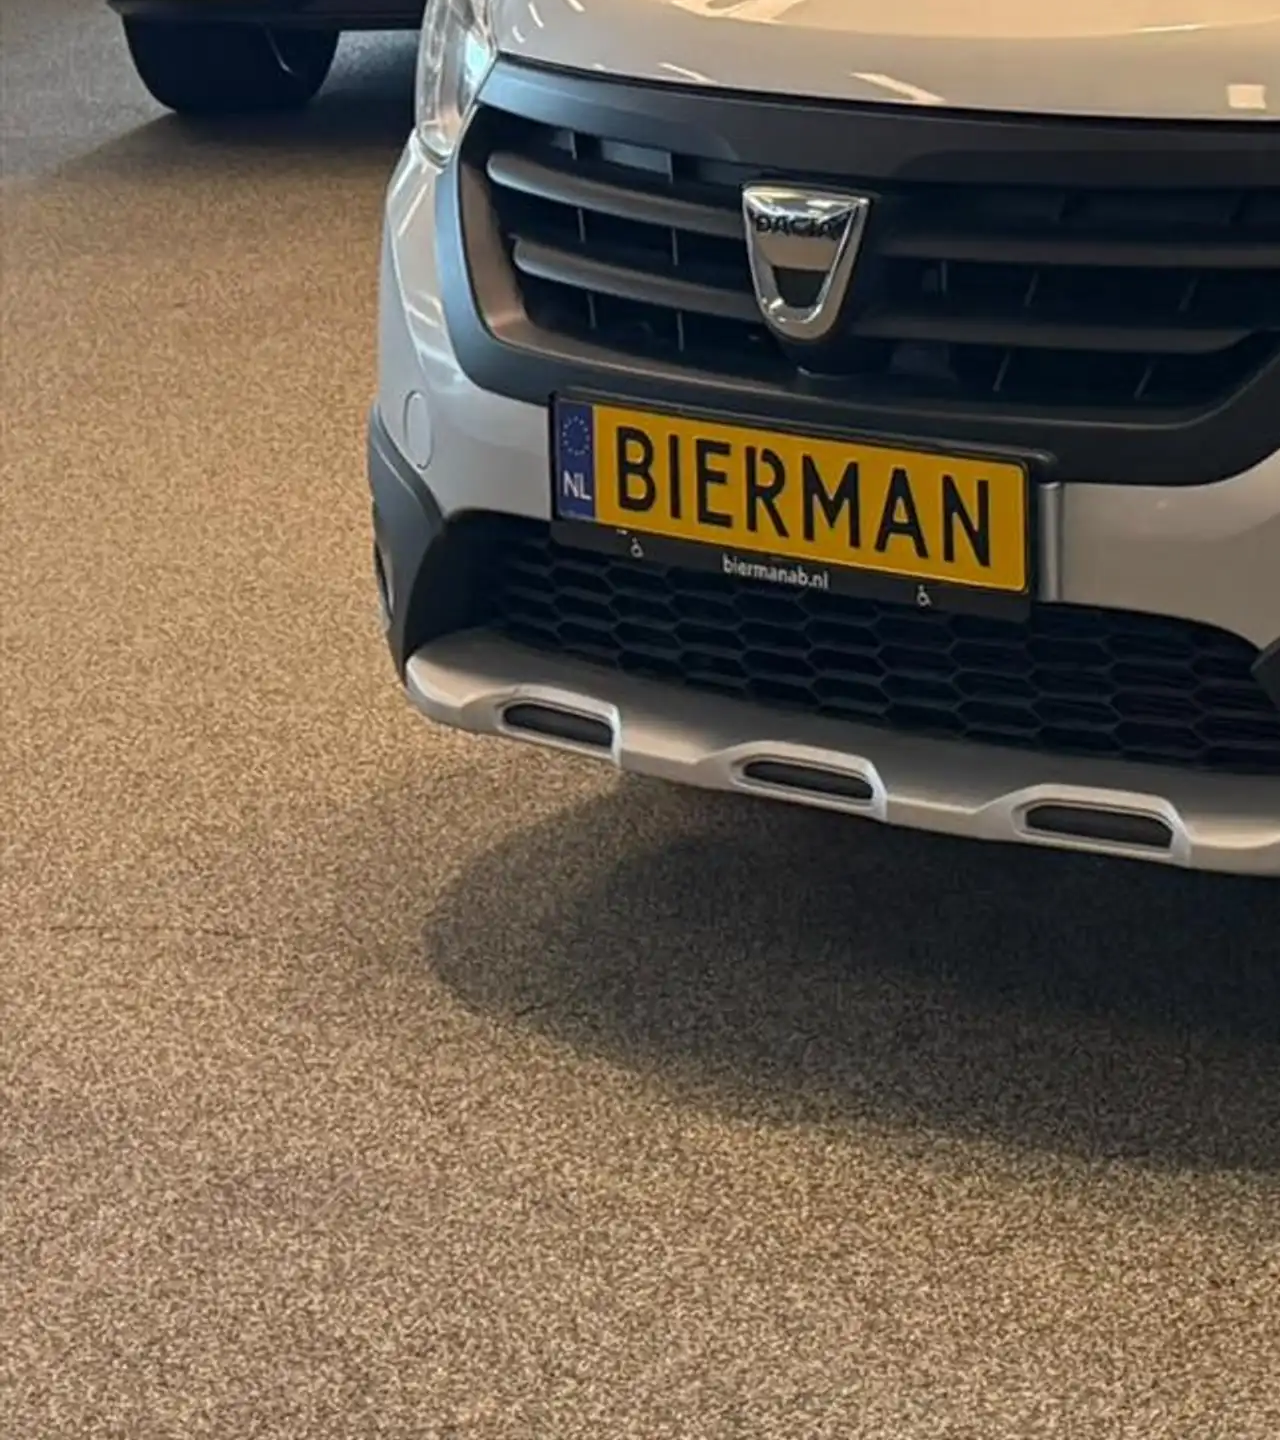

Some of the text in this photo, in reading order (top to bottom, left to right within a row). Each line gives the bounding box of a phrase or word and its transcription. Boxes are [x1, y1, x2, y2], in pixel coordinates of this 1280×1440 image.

[563, 425, 991, 567] NL BIERMAN
[722, 552, 830, 591] biermanab.nl
